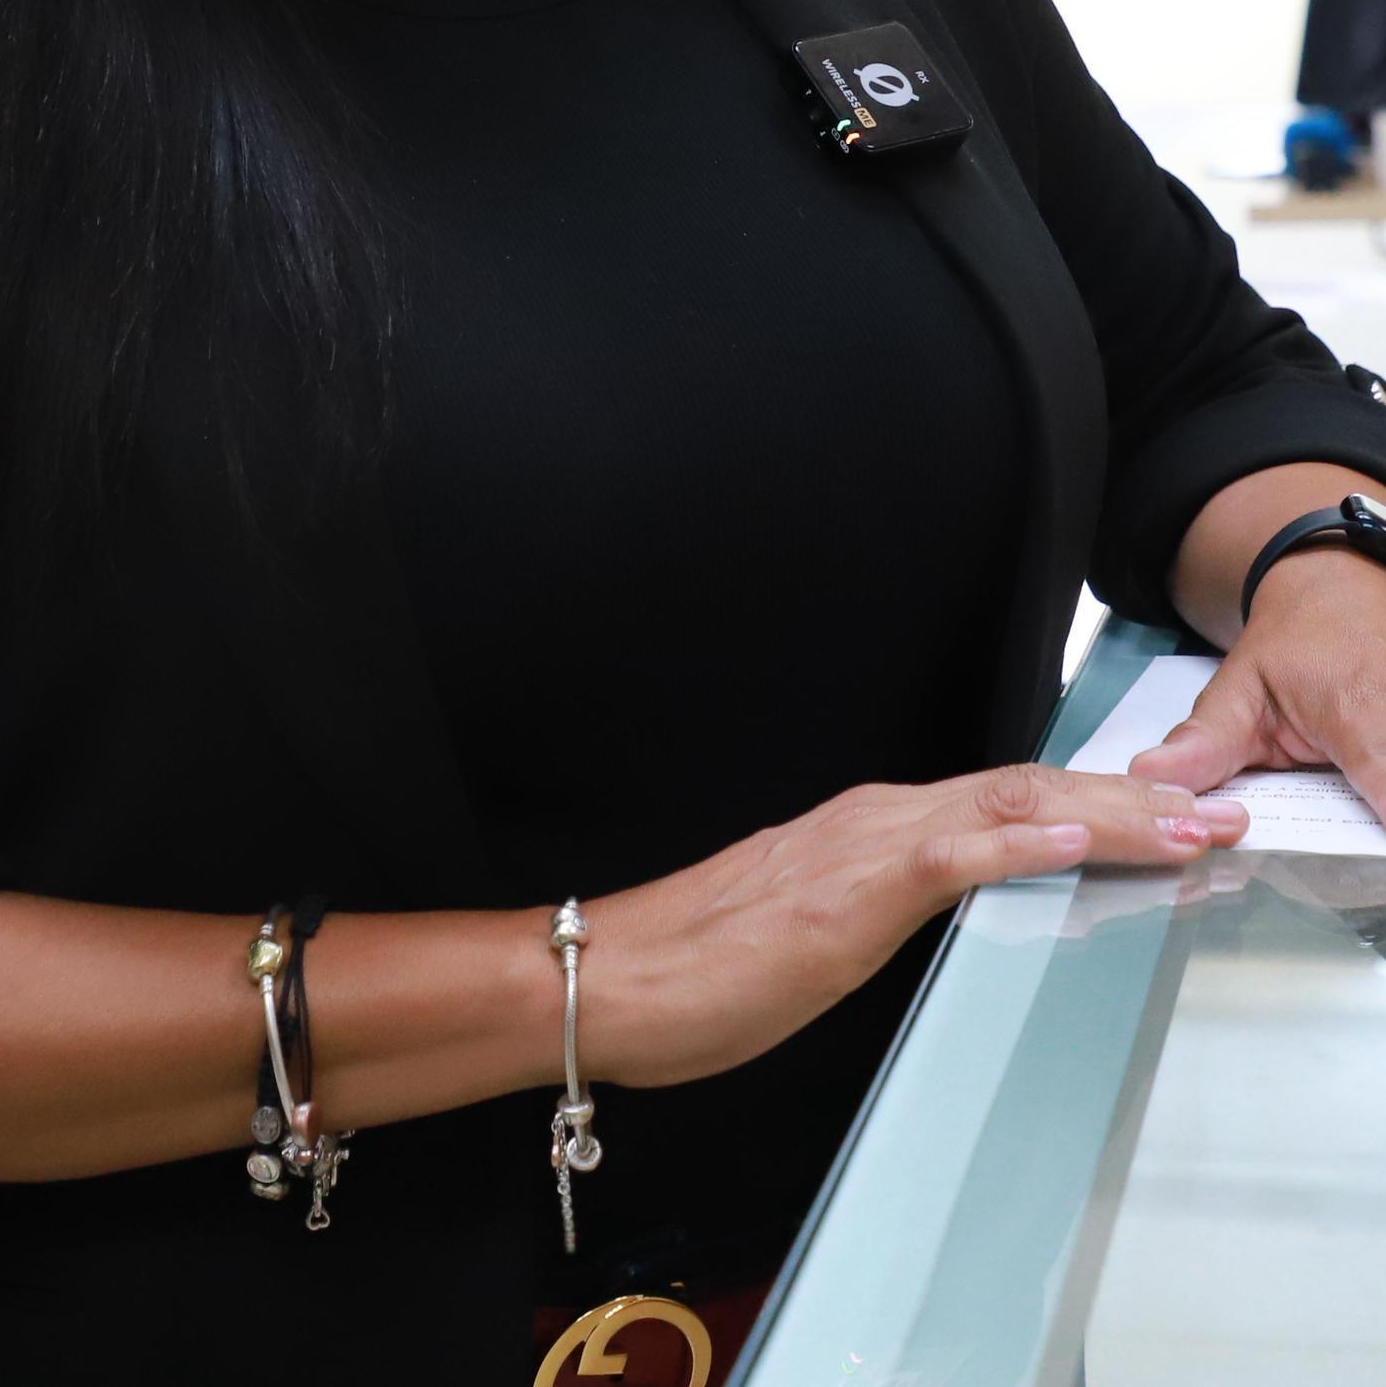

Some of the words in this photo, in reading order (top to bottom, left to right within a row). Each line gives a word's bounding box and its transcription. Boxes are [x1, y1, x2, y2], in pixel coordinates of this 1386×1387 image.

[821, 58, 862, 109] WIRELESS
[856, 109, 875, 127] ME
[914, 70, 930, 84] RX
